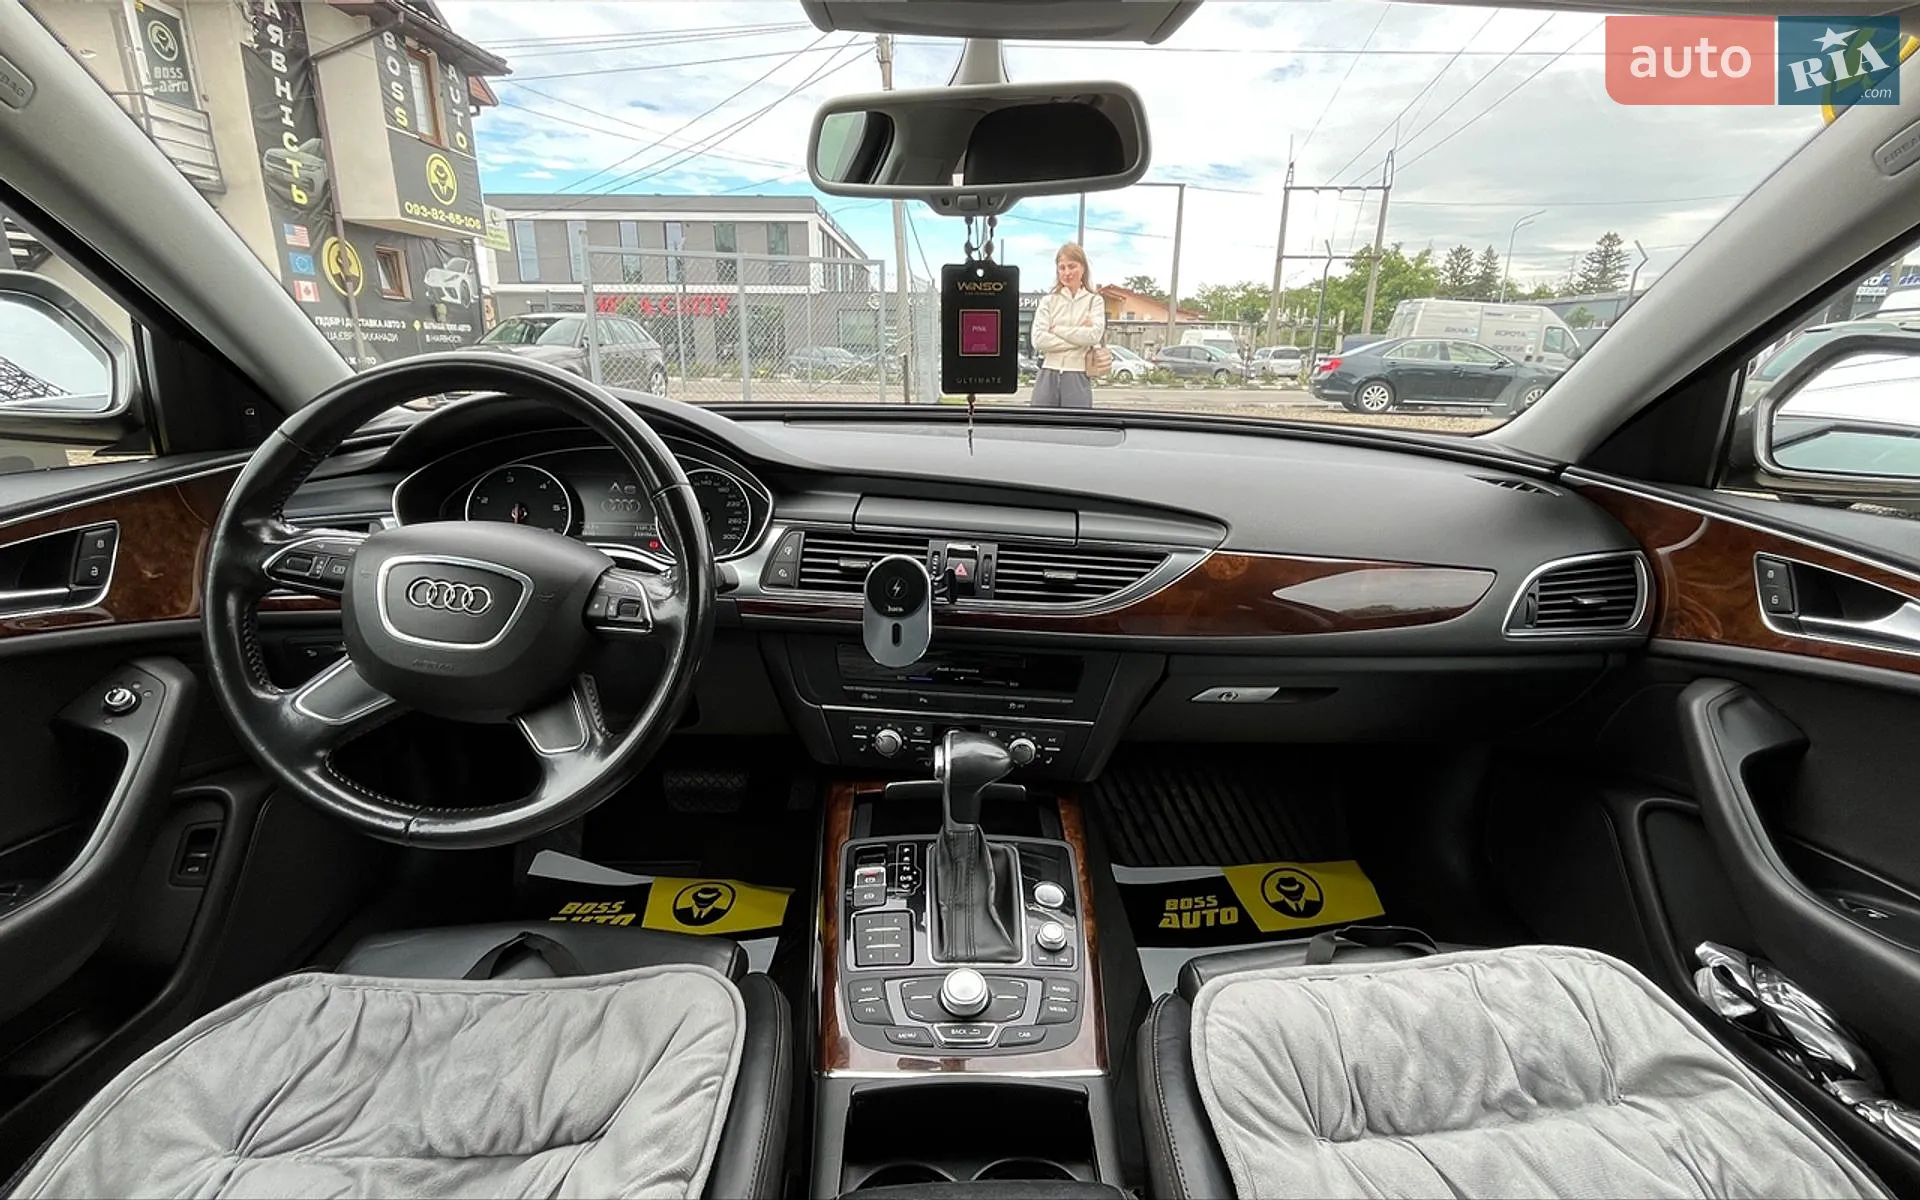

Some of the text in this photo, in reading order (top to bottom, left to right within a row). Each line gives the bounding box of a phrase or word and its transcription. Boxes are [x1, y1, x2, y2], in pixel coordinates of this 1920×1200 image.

[153, 66, 183, 80] BOSS
[383, 30, 408, 128] BOSS
[448, 63, 468, 150] AUTO
[558, 900, 626, 915] BOSS
[1165, 895, 1218, 911] BOSS
[1158, 907, 1239, 930] AUTO
[951, 1028, 966, 1036] BACK
